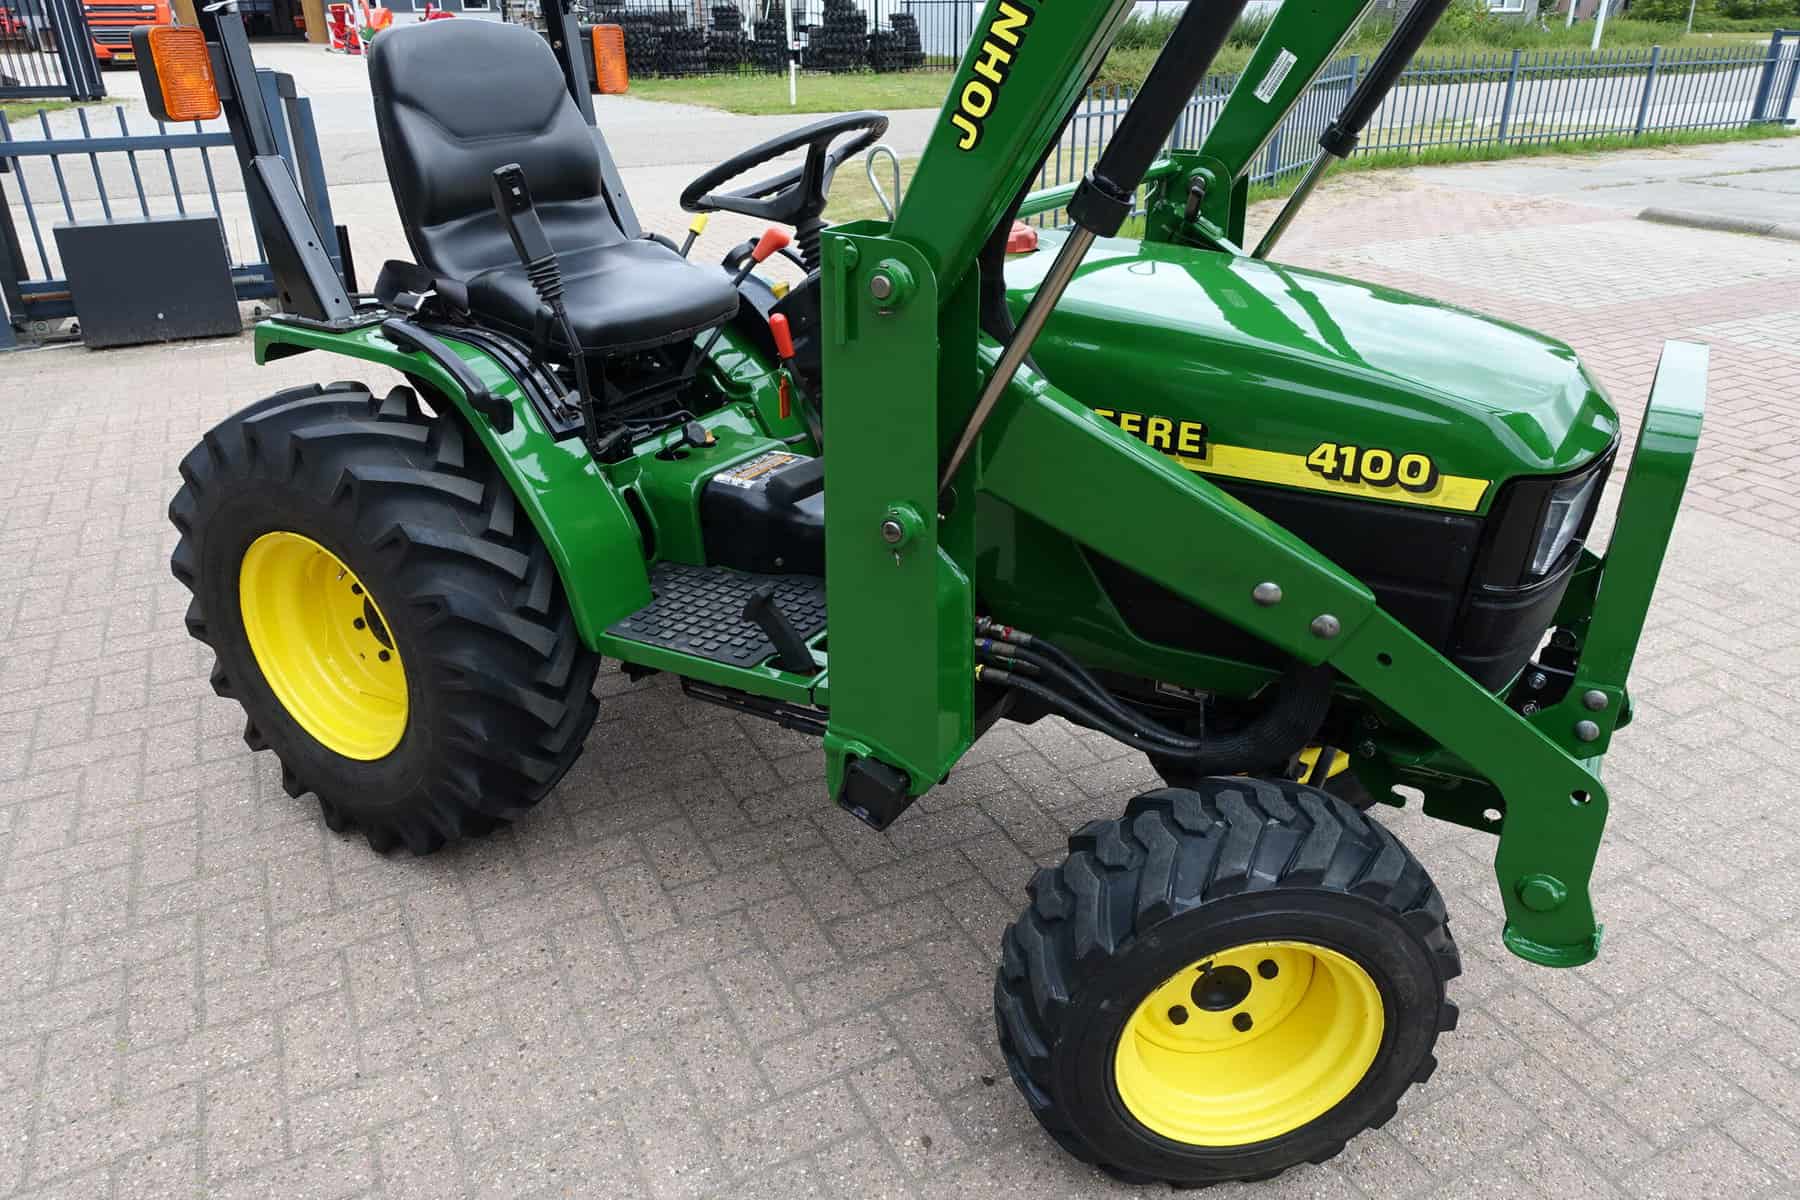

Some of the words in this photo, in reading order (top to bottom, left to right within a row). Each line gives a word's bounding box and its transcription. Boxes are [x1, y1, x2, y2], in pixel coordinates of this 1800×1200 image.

[951, 1, 1031, 151] JOHN
[1094, 408, 1205, 456] ERE
[1306, 442, 1435, 489] 4100
